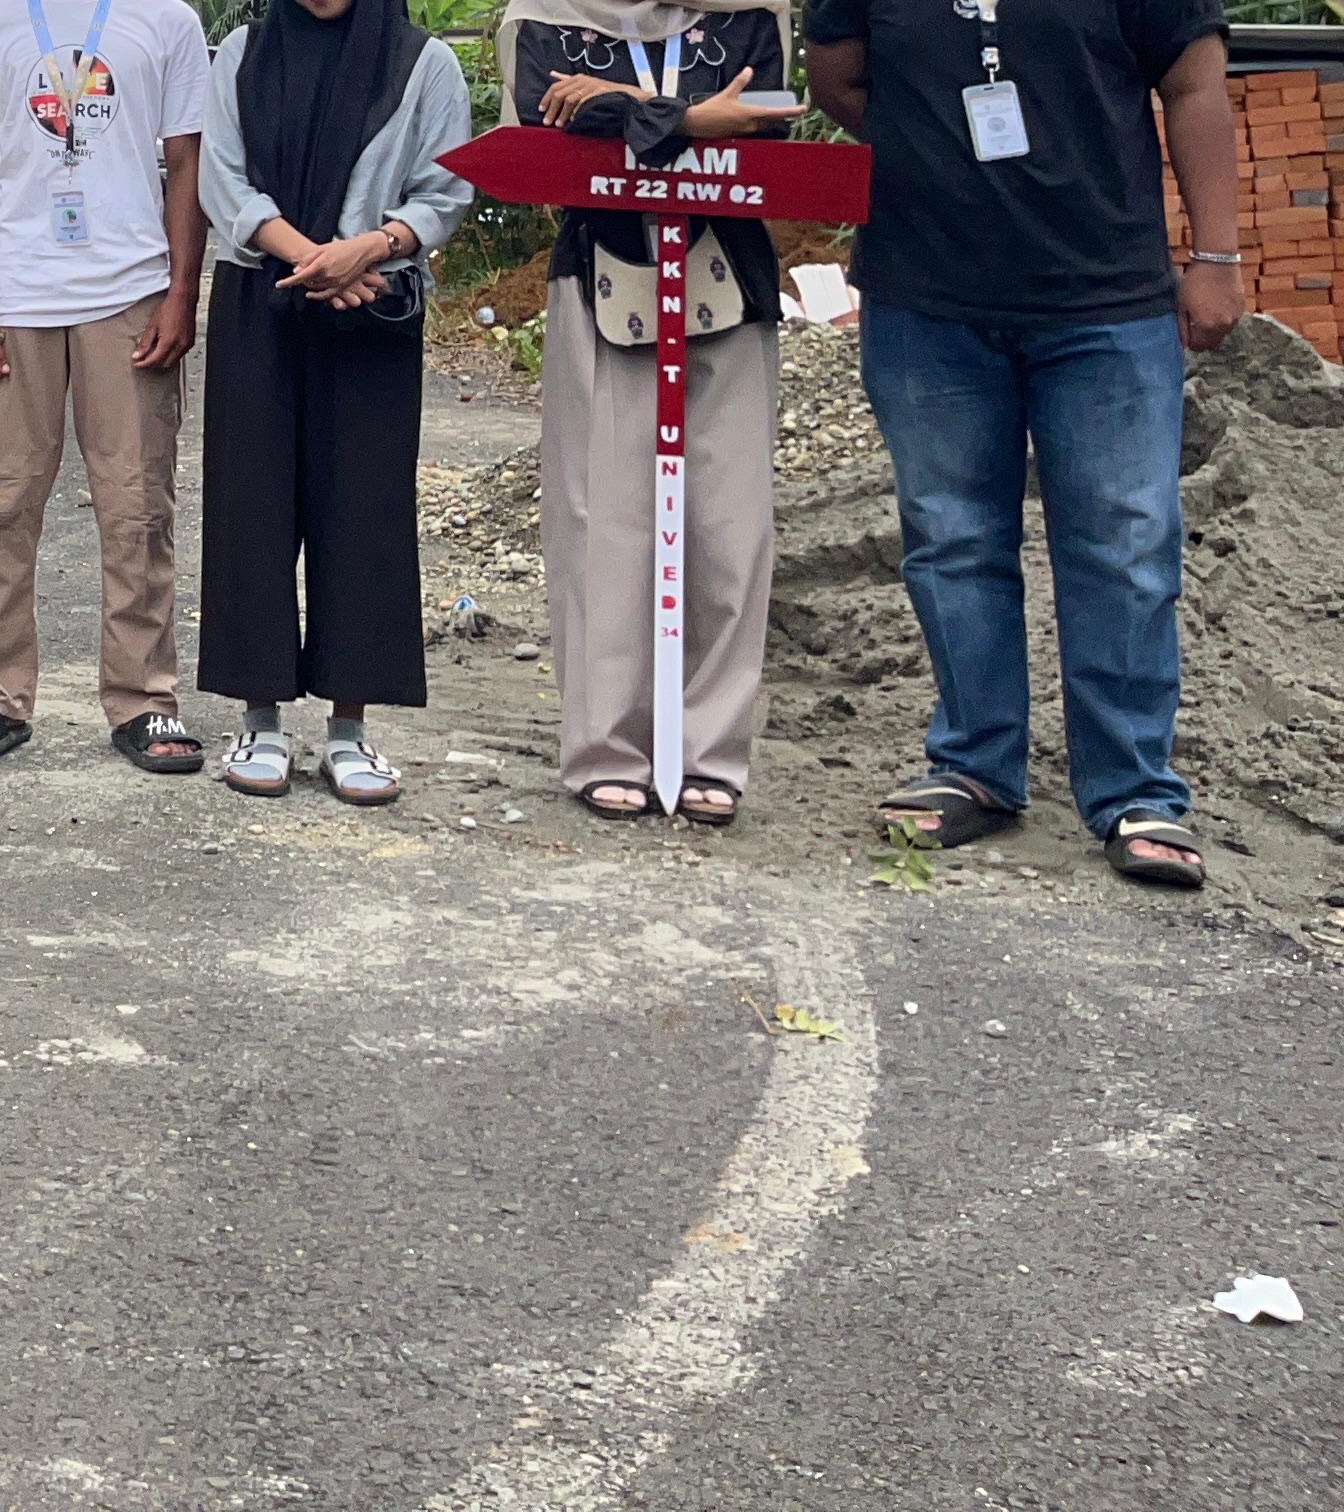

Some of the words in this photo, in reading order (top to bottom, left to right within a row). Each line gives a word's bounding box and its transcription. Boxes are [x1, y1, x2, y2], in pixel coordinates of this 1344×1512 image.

[39, 73, 108, 90] LE
[625, 143, 738, 176] IAM
[590, 175, 627, 196] RT
[634, 179, 668, 198] 22
[677, 182, 722, 202] RW
[729, 185, 763, 205] 02
[660, 627, 680, 637] 34
[145, 714, 187, 736] H&M
